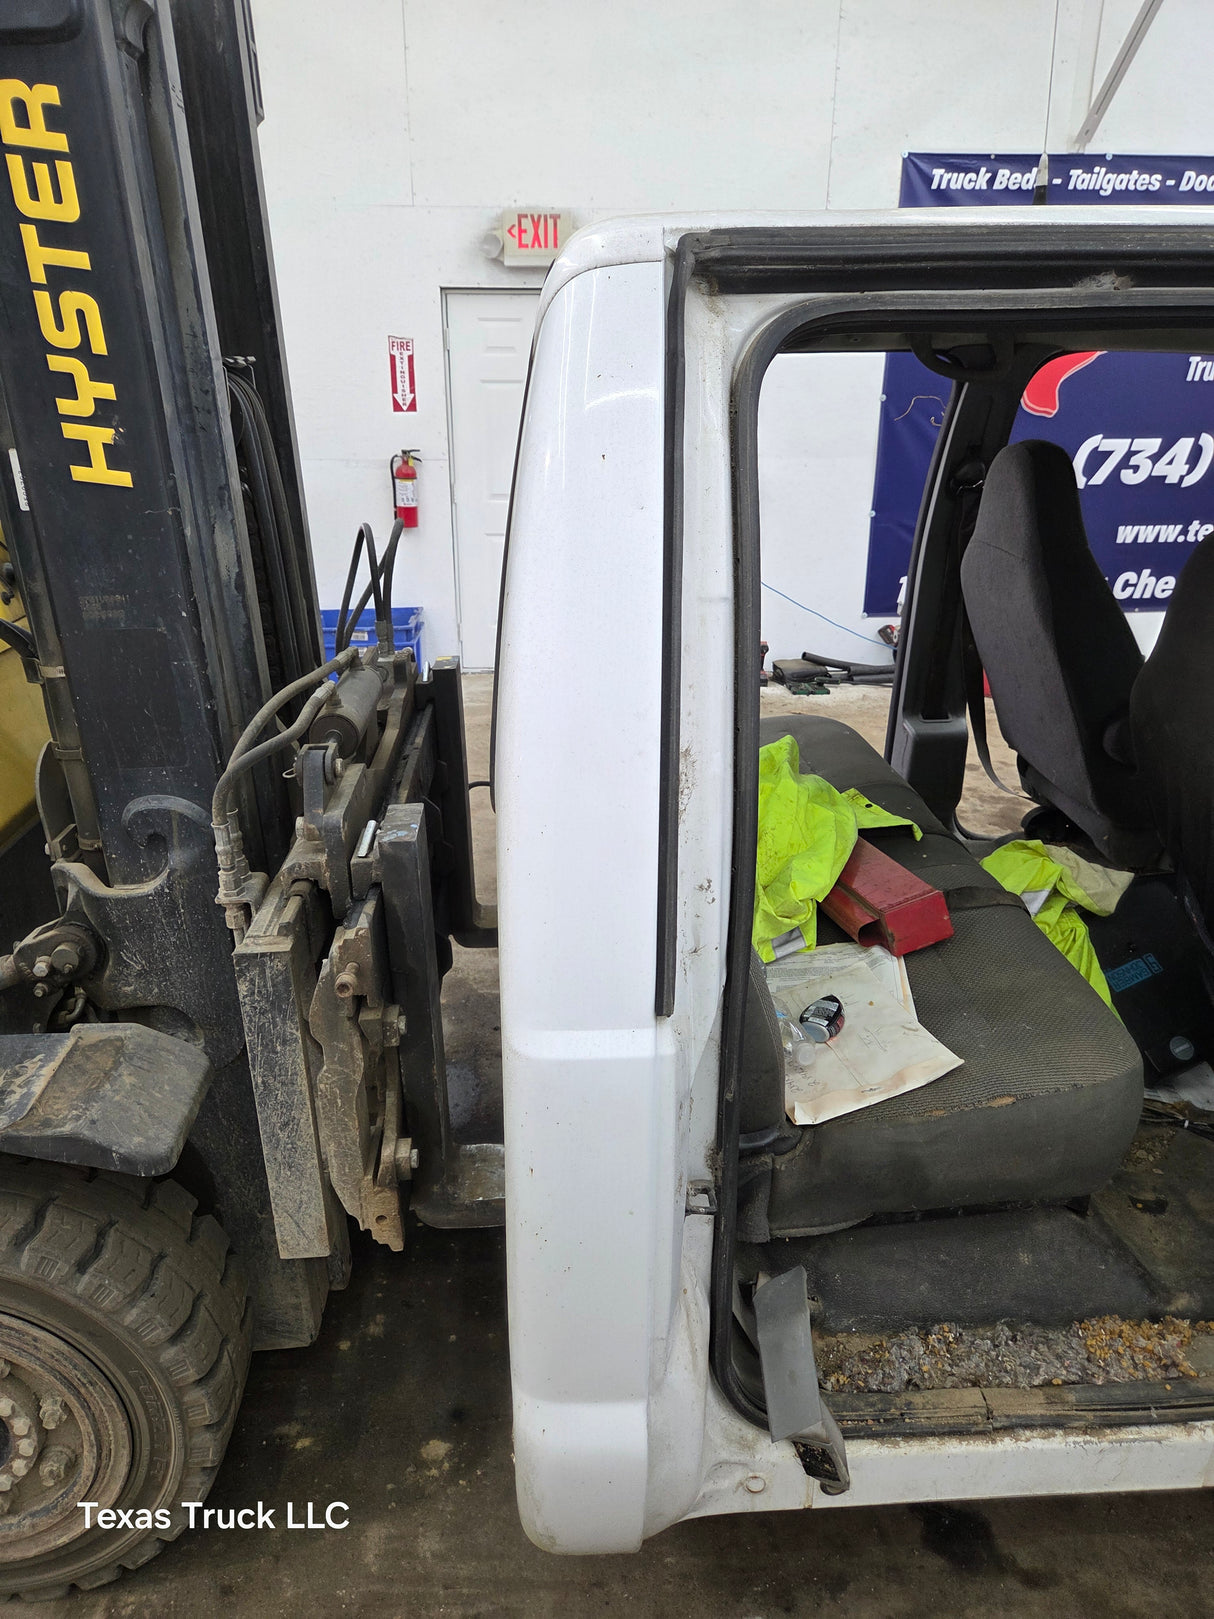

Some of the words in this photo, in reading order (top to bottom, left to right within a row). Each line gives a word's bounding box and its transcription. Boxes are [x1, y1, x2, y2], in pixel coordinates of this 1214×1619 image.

[931, 167, 991, 190] Truck
[992, 166, 1041, 191] Bed
[1067, 166, 1162, 196] Tailgates
[516, 213, 561, 249] EXIT
[0, 79, 134, 488] HYSTER
[391, 340, 411, 352] FIRE
[1072, 432, 1214, 489] (734)
